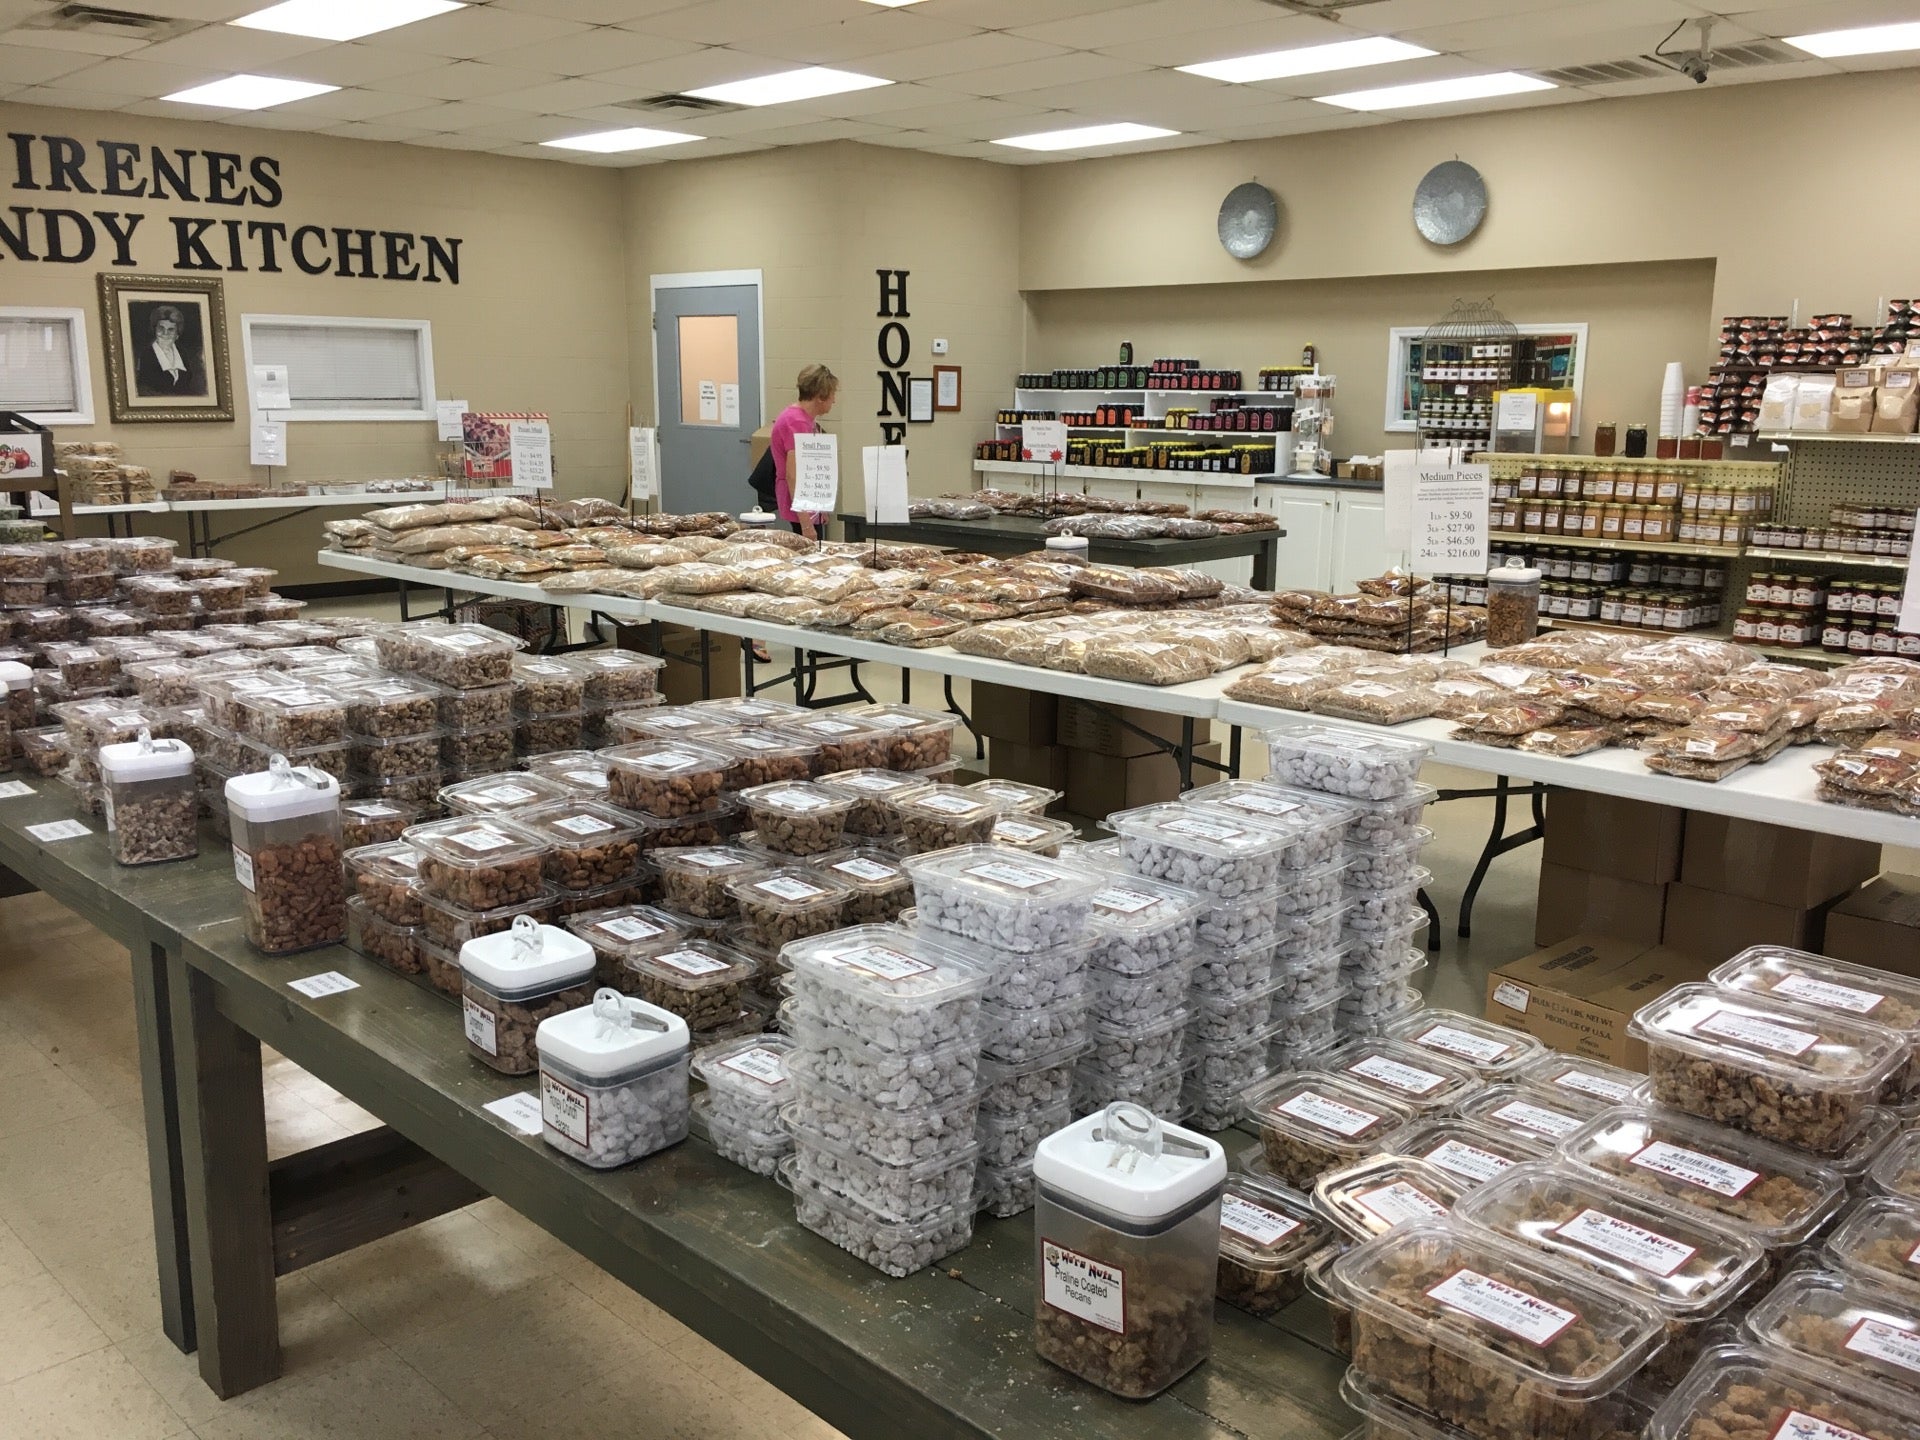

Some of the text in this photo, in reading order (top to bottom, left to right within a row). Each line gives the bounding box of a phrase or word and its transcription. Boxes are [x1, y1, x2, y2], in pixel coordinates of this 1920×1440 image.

[8, 132, 283, 208] IRENES
[168, 215, 463, 285] KITCHEN
[876, 269, 911, 476] HONE
[802, 442, 816, 450] Small
[1420, 471, 1483, 481] Medium Pieces
[1449, 511, 1473, 520] $9.50
[1447, 523, 1475, 533] $27.90
[1446, 536, 1475, 545] $46.50
[1447, 548, 1480, 558] $216.00
[1544, 1013, 1579, 1030] PRODUCE
[1580, 1024, 1591, 1034] OF
[1055, 1267, 1080, 1288] Praline
[1080, 1277, 1108, 1298] Coated
[1065, 1285, 1092, 1305] Pecans
